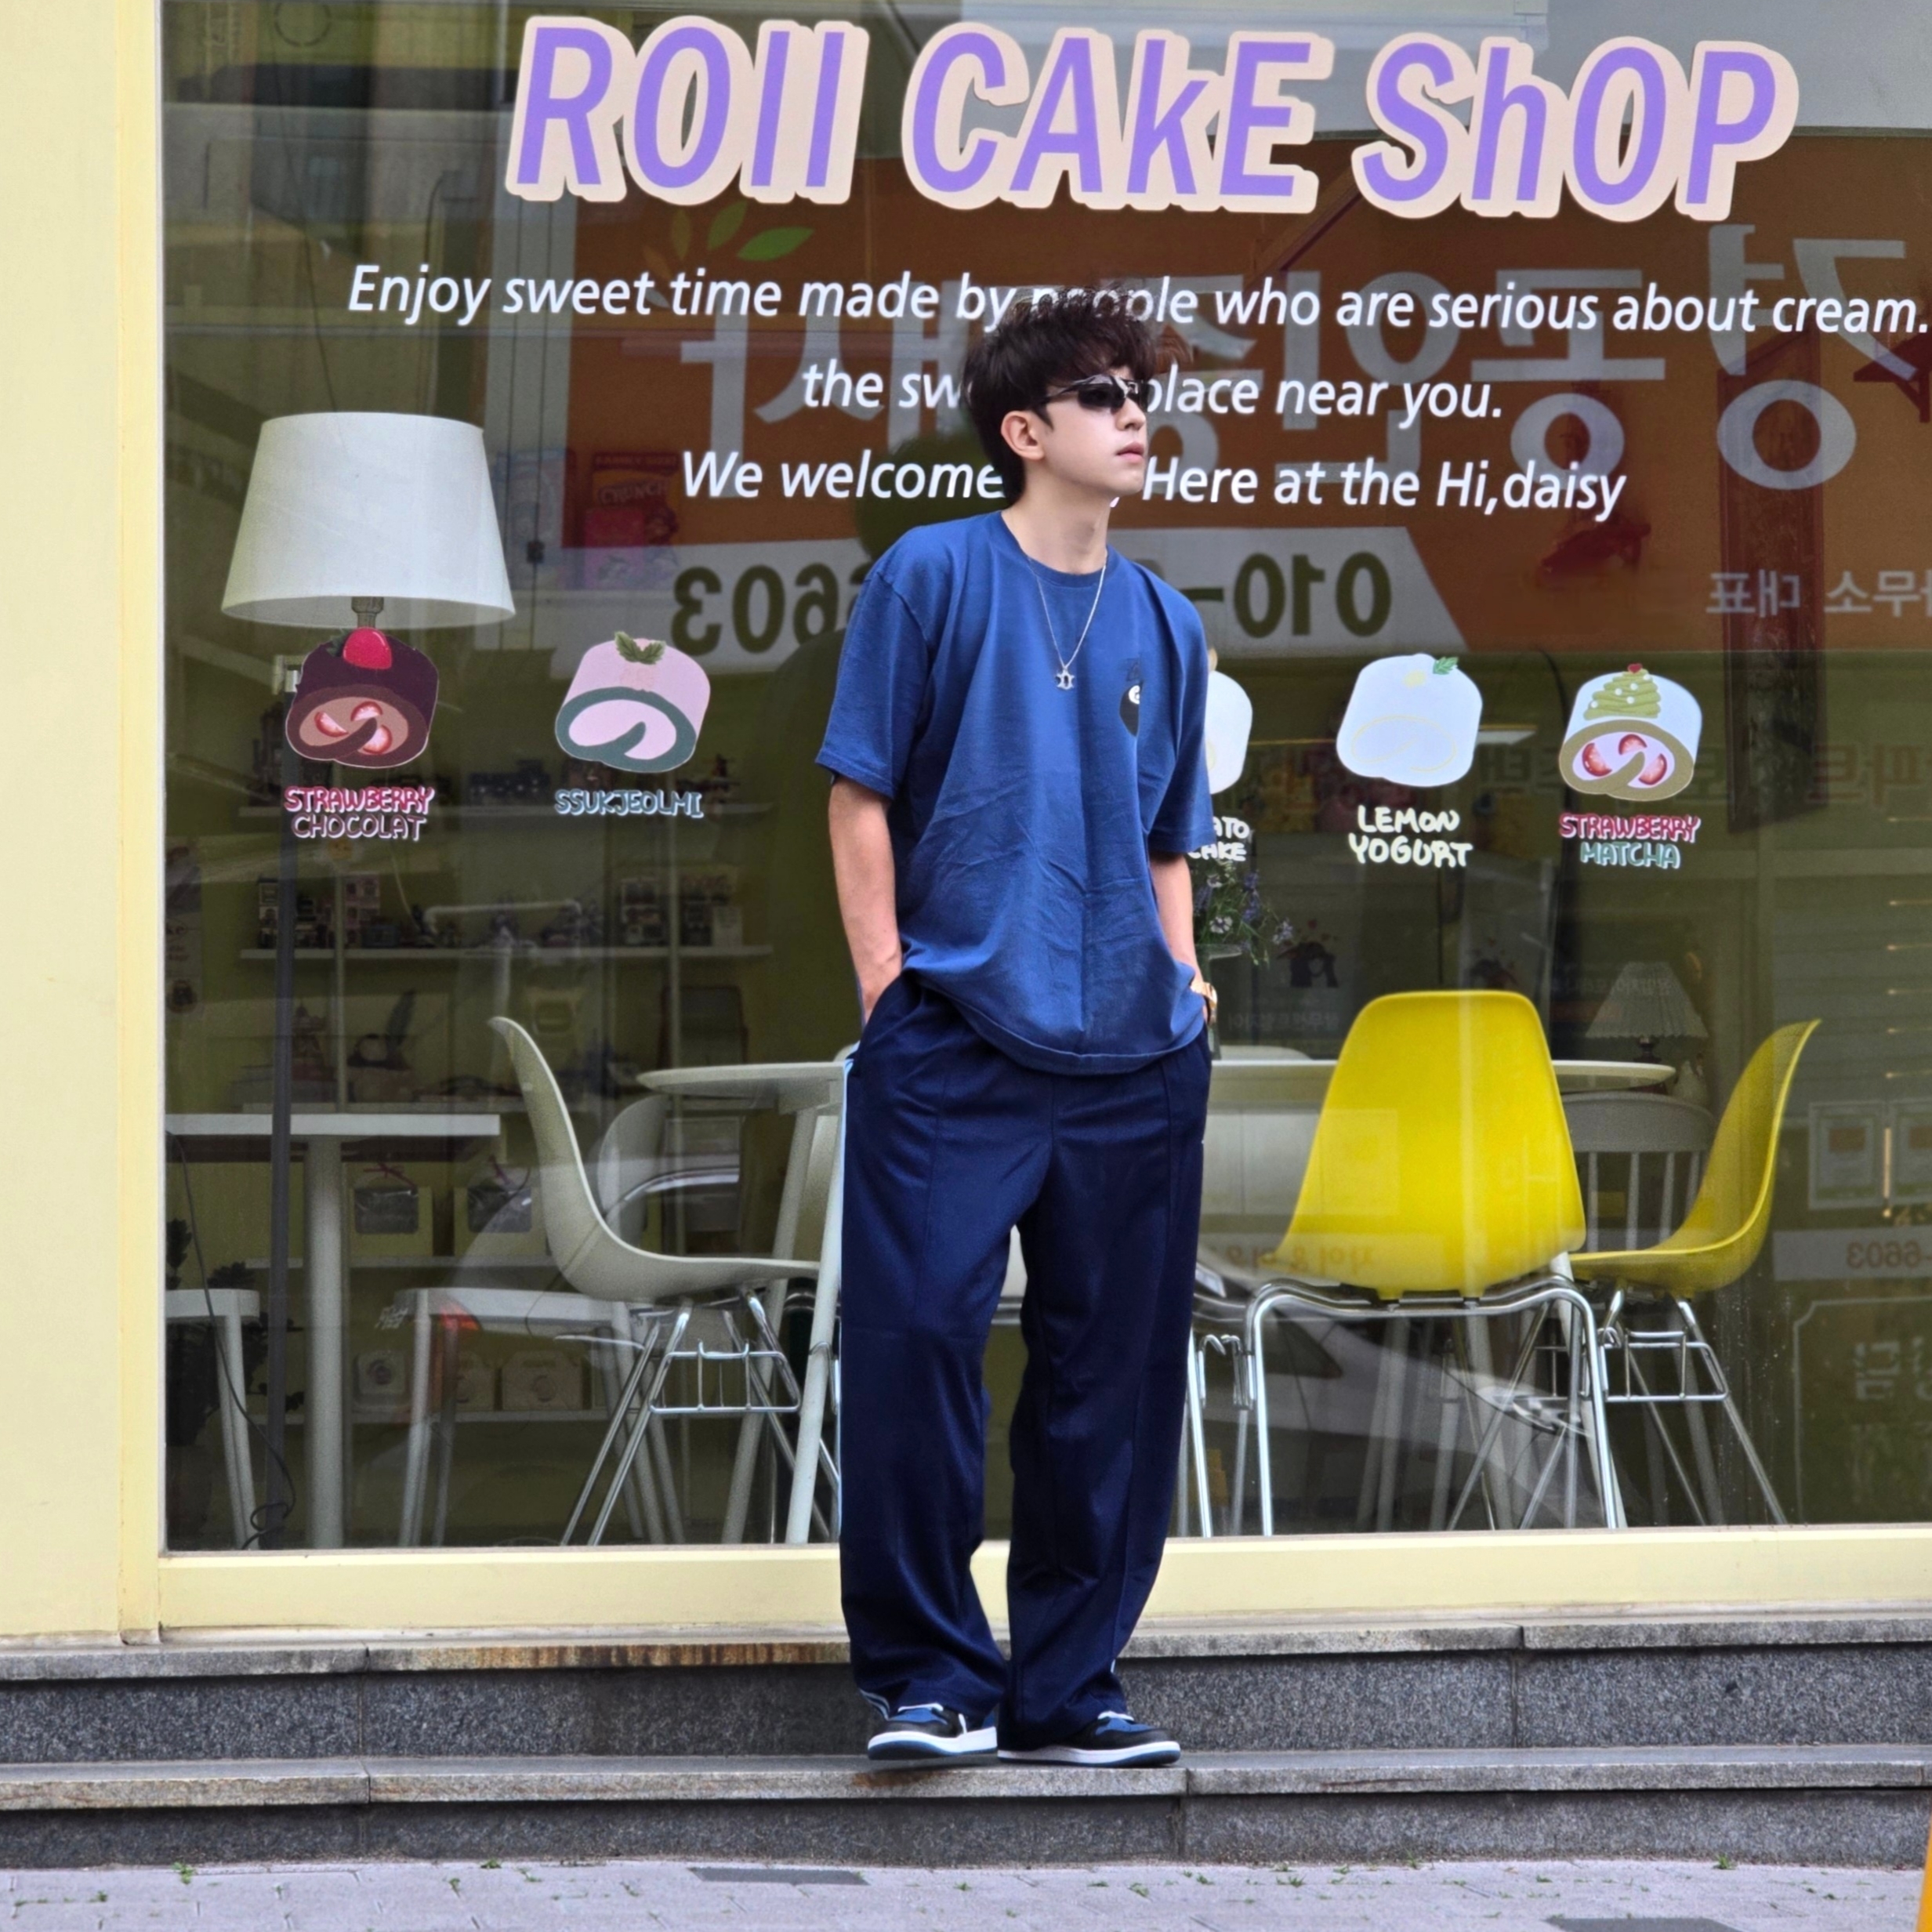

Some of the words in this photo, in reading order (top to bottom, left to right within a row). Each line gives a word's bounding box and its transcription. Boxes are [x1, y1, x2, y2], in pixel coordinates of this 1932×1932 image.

[348, 263, 492, 326] Enjoy
[502, 272, 655, 316] sweet
[669, 267, 782, 317] time
[798, 270, 940, 320] made
[955, 272, 1018, 334] by
[1214, 276, 1321, 326] who
[1336, 291, 1415, 328] are
[1428, 281, 1599, 331] serious
[1612, 281, 1760, 332] about
[1772, 297, 1930, 334] cream.
[802, 357, 884, 408] the
[1276, 379, 1390, 416] near
[1398, 382, 1502, 430] you.
[683, 451, 763, 499] We
[781, 449, 1004, 499] welcome
[1142, 456, 1259, 504] Here
[1274, 461, 1327, 506] at
[1339, 457, 1420, 507] the
[1436, 459, 1627, 523] Hi,daisy
[284, 785, 436, 815] STRAWBERRY
[553, 788, 705, 819] SSUKJEOLMI
[291, 813, 427, 842] CHOCOLAT
[1357, 803, 1461, 834] LEMON
[1558, 813, 1702, 843] STRAWBERRY
[1347, 832, 1474, 868] YOGURT
[1579, 841, 1682, 869] MATCHA
